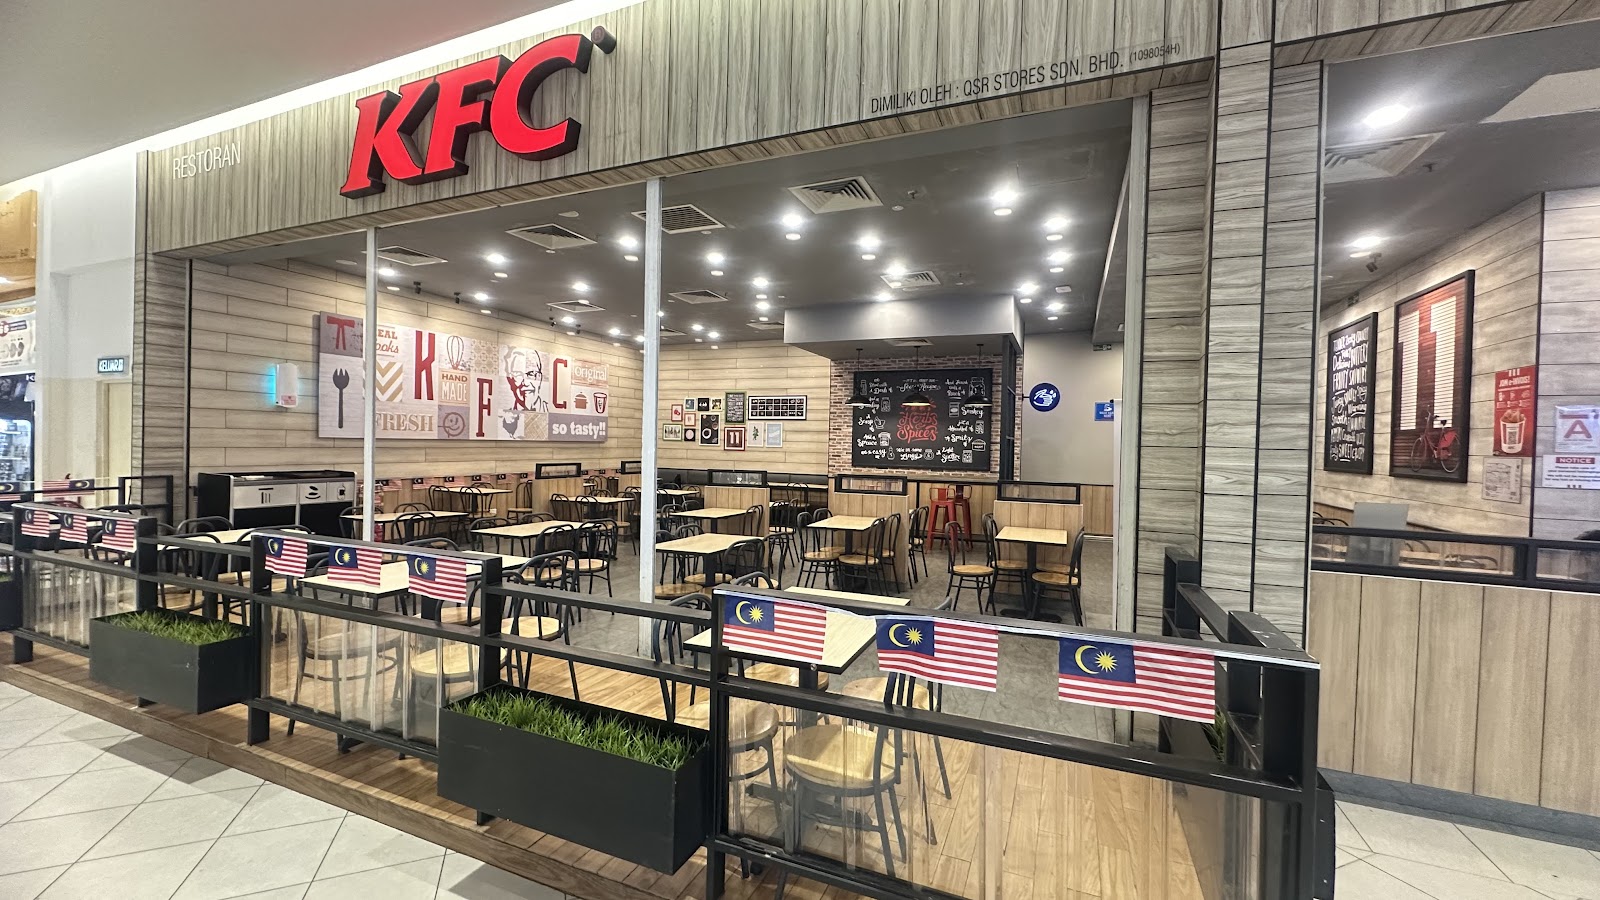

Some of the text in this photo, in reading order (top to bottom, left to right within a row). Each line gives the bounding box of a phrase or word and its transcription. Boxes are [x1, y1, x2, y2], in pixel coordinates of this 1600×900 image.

[871, 92, 917, 113] DIMILIKI
[920, 84, 952, 105] OLEH
[963, 76, 989, 97] QSR
[993, 66, 1045, 91] STORES
[1049, 58, 1083, 81] SDN.
[1089, 51, 1124, 74] BHD.
[340, 33, 592, 199] KFC
[172, 141, 241, 179] RESTORAN
[377, 328, 398, 340] EAL
[375, 340, 399, 353] ooks
[441, 373, 468, 382] HAND
[574, 365, 608, 382] Original
[441, 382, 468, 402] MADE
[552, 421, 607, 437] so tasty!!
[896, 425, 938, 444] Spices
